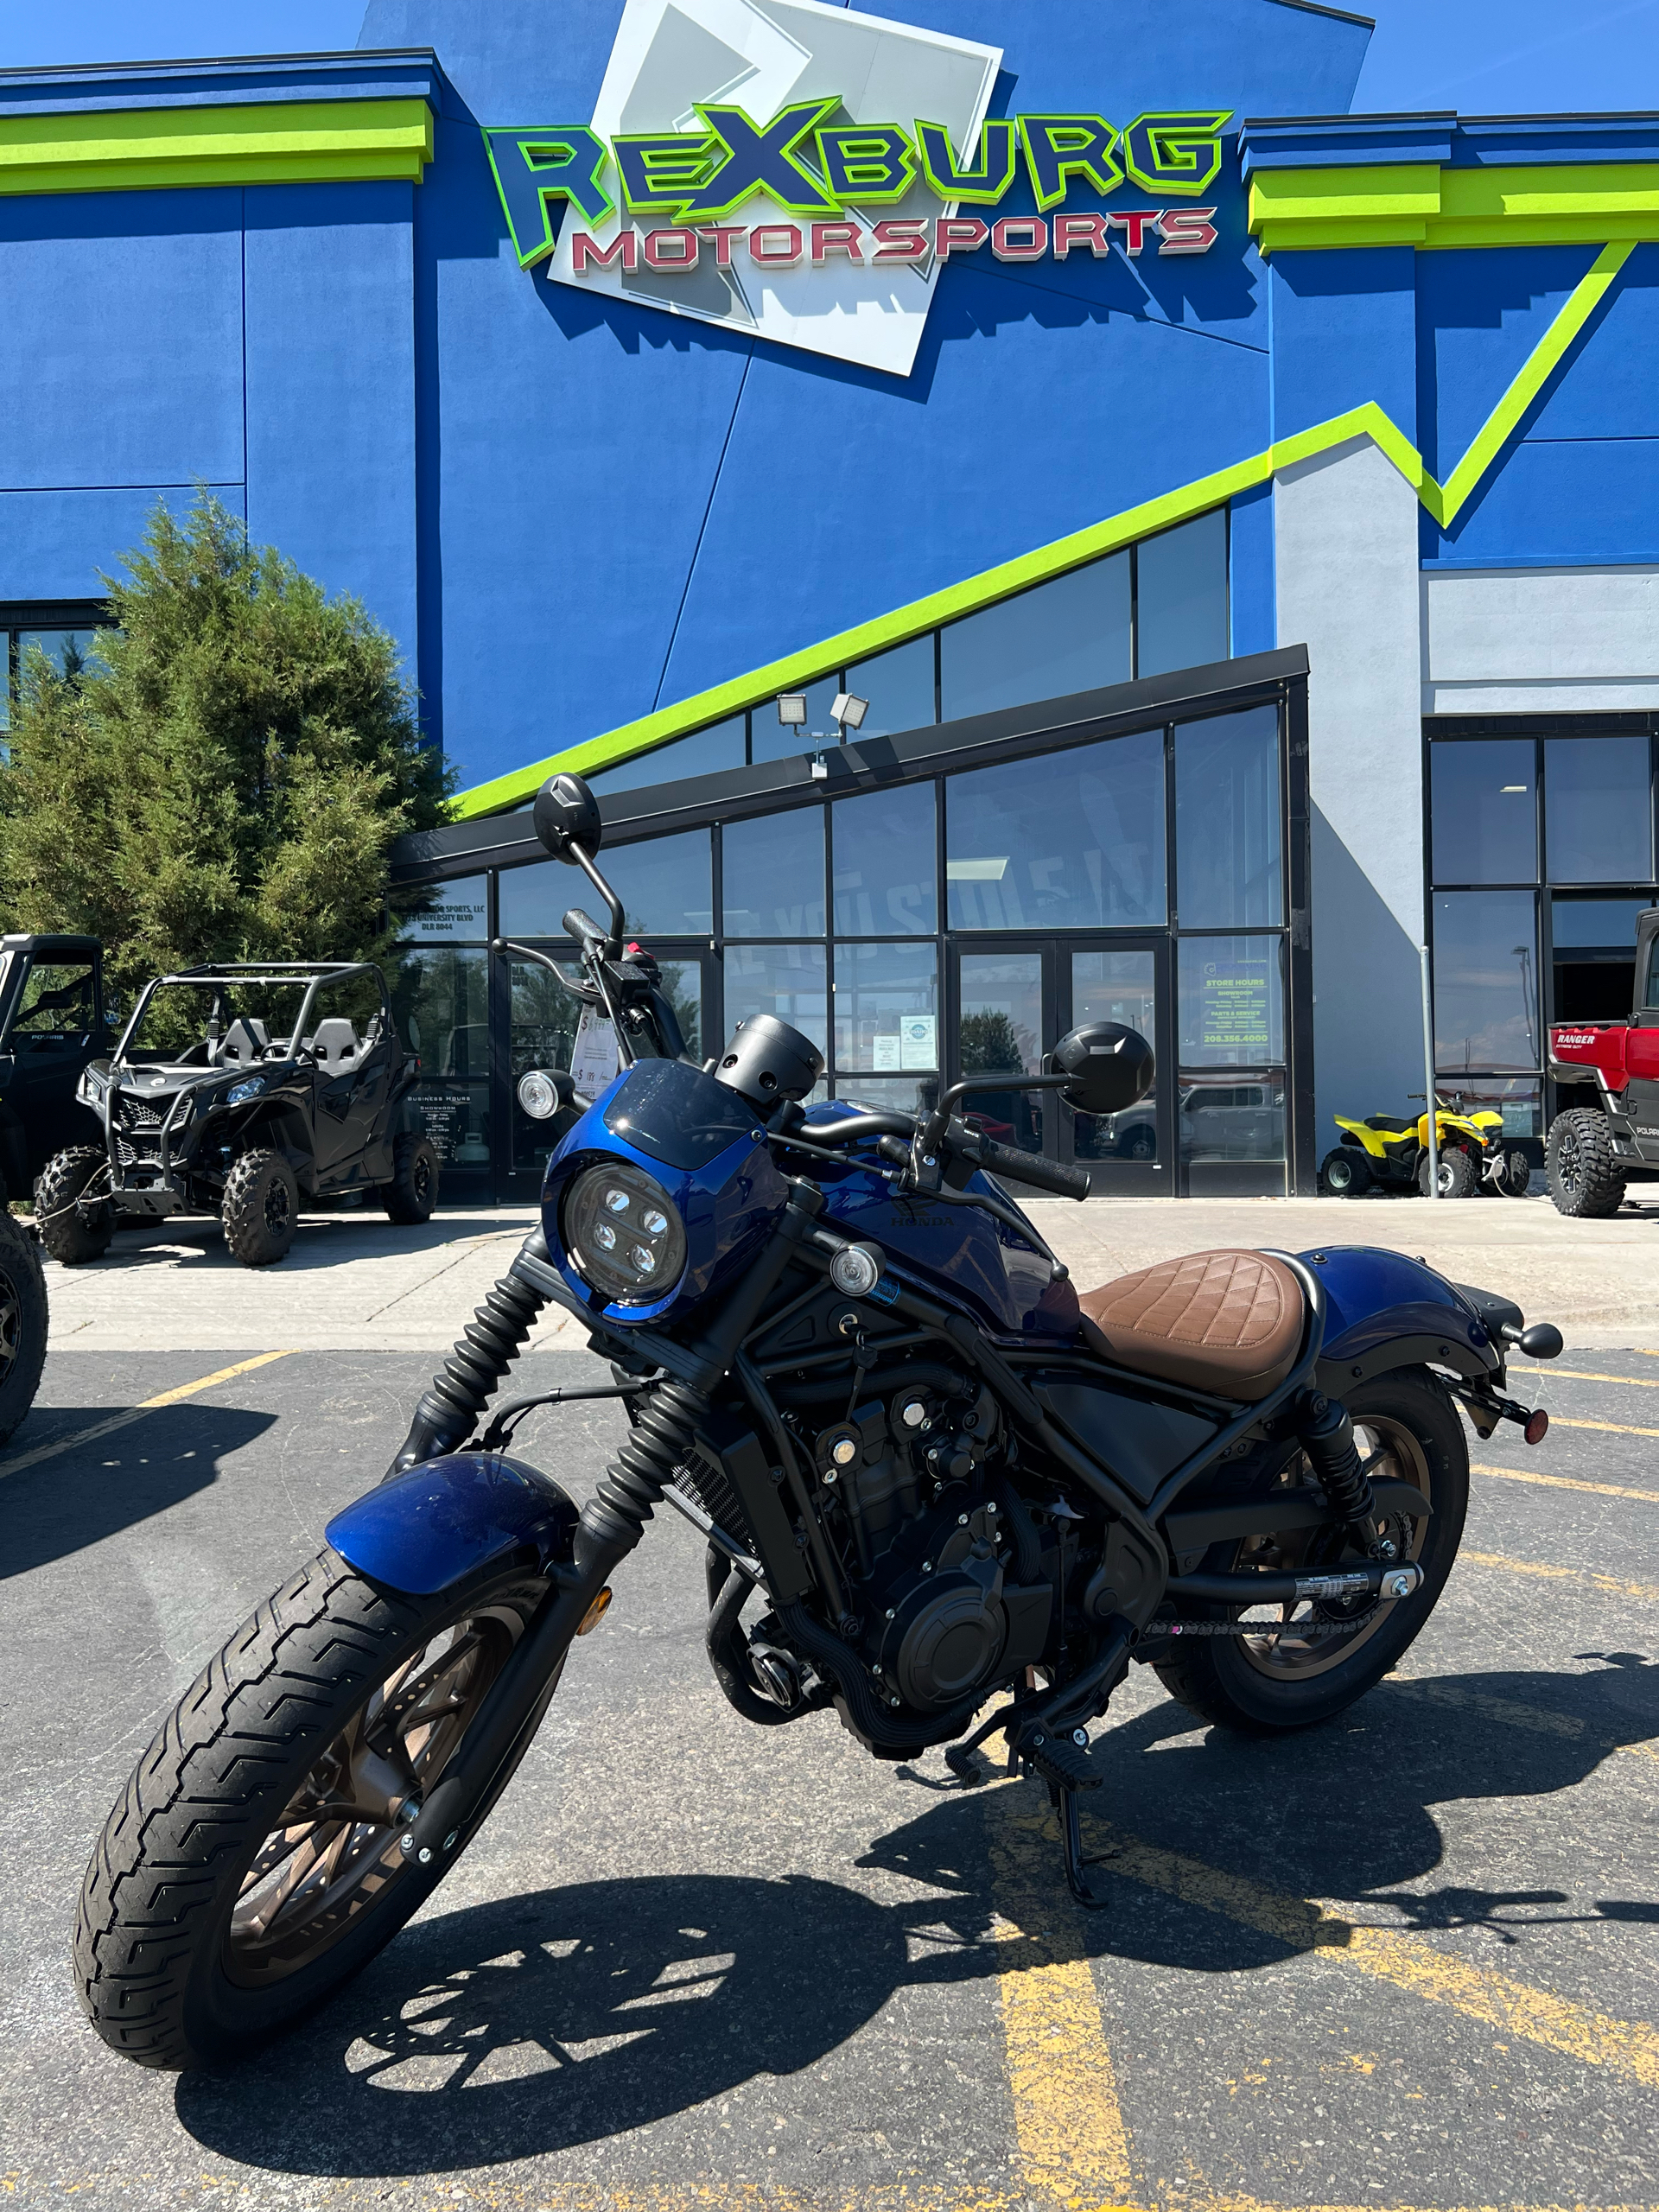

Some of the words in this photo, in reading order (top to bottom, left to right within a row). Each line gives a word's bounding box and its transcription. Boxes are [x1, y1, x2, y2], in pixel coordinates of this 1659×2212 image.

[483, 95, 1236, 270] REXBURG
[570, 207, 1217, 276] MOTORSPORTS
[1204, 1034, 1268, 1043] 208.356.4000
[1557, 1034, 1596, 1044] RANGER
[890, 1217, 955, 1226] HONDA
